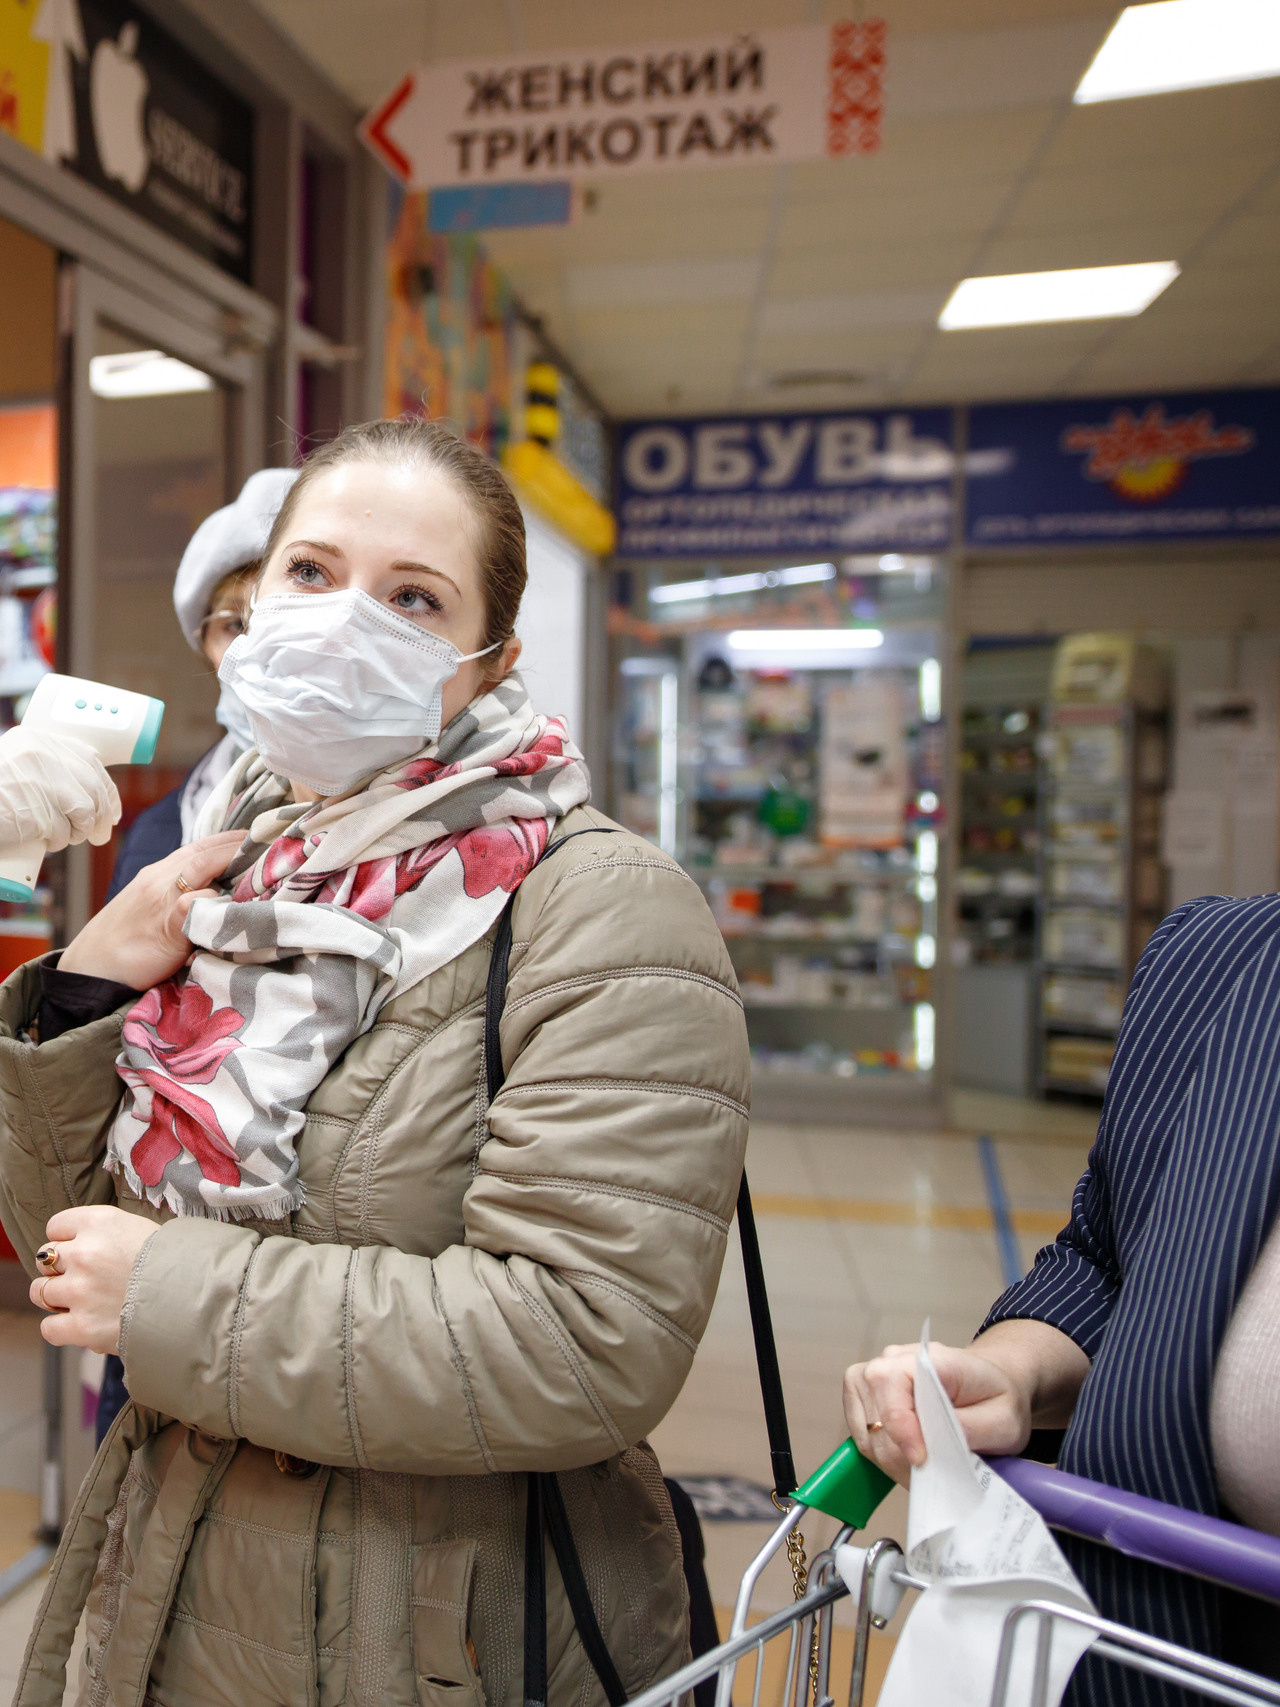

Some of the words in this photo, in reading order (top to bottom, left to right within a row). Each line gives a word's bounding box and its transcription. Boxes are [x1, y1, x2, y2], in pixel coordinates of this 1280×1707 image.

[465, 33, 765, 117] ЖЕНСКИЙ
[448, 104, 778, 175] ТРИКОТАЖ
[624, 415, 953, 492] ОБУВЬ
